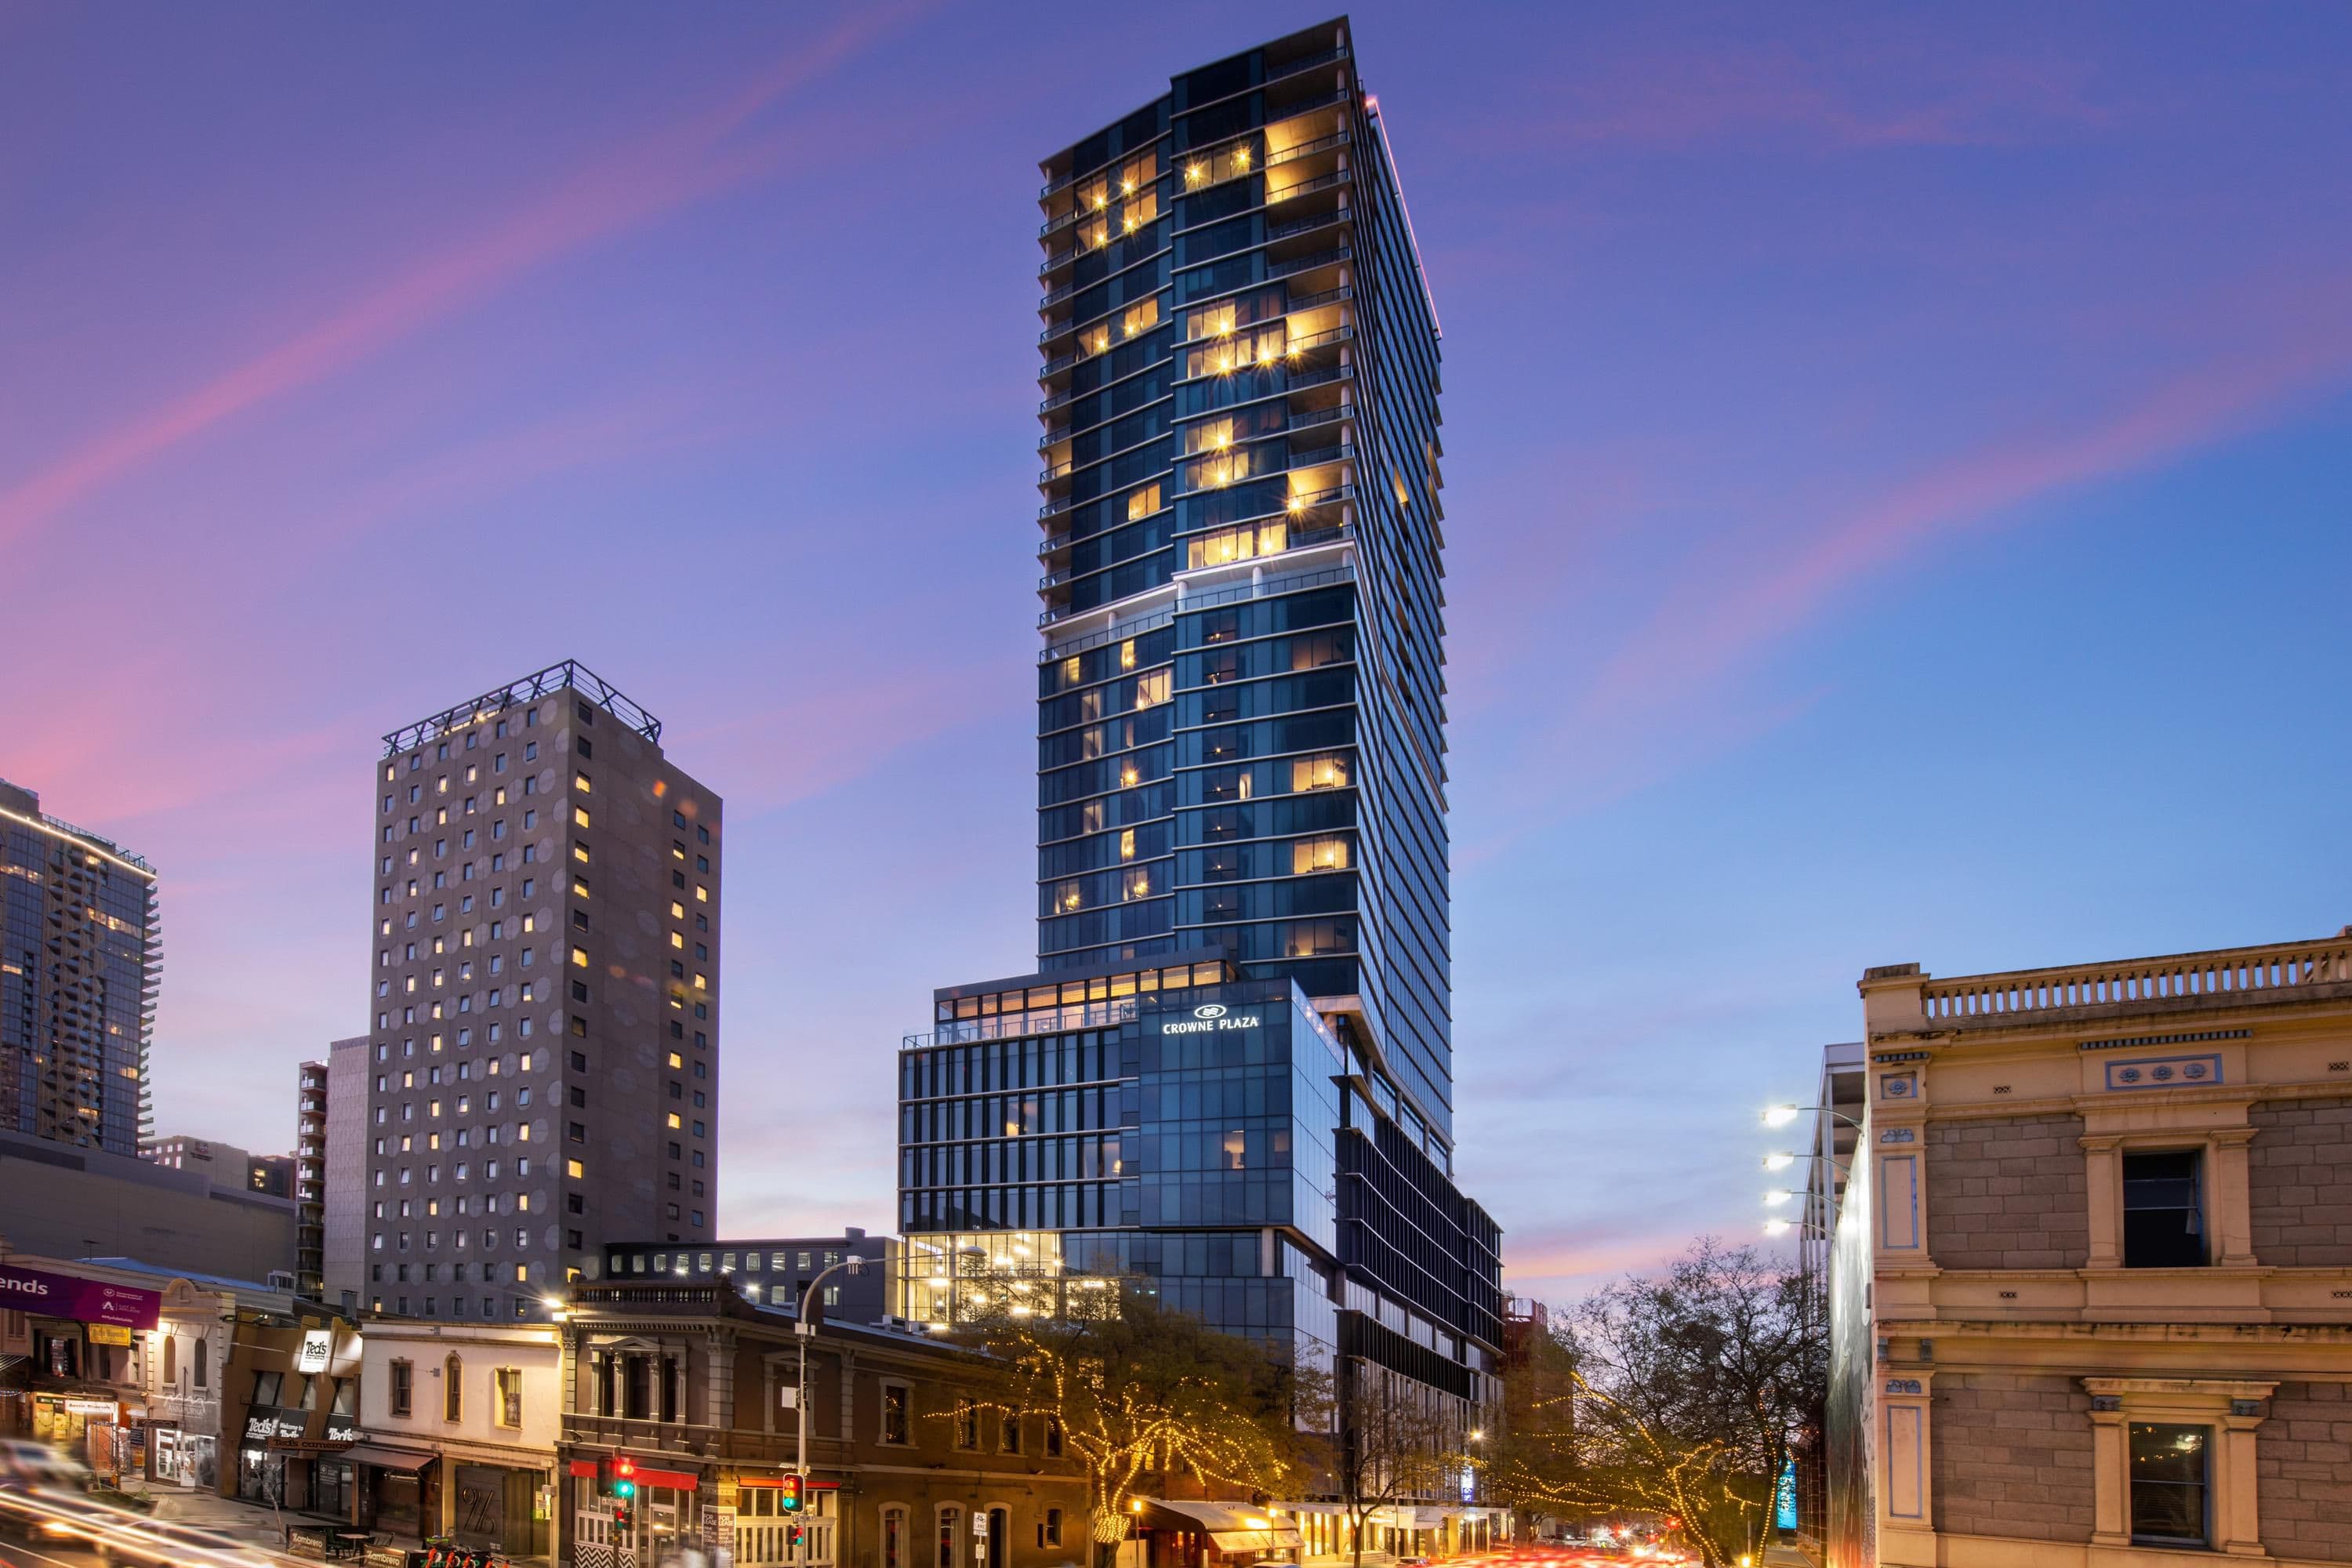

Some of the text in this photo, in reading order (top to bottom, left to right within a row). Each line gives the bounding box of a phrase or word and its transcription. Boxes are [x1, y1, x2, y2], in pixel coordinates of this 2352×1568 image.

[1163, 1016, 1258, 1034] CROWNE PLAZA
[0, 1277, 49, 1294] ends
[307, 1341, 327, 1355] Ted's
[249, 1417, 272, 1434] Ted's
[274, 1439, 298, 1447] Ted's
[292, 1533, 323, 1548] Zambrero
[366, 1550, 400, 1566] Zambrero
